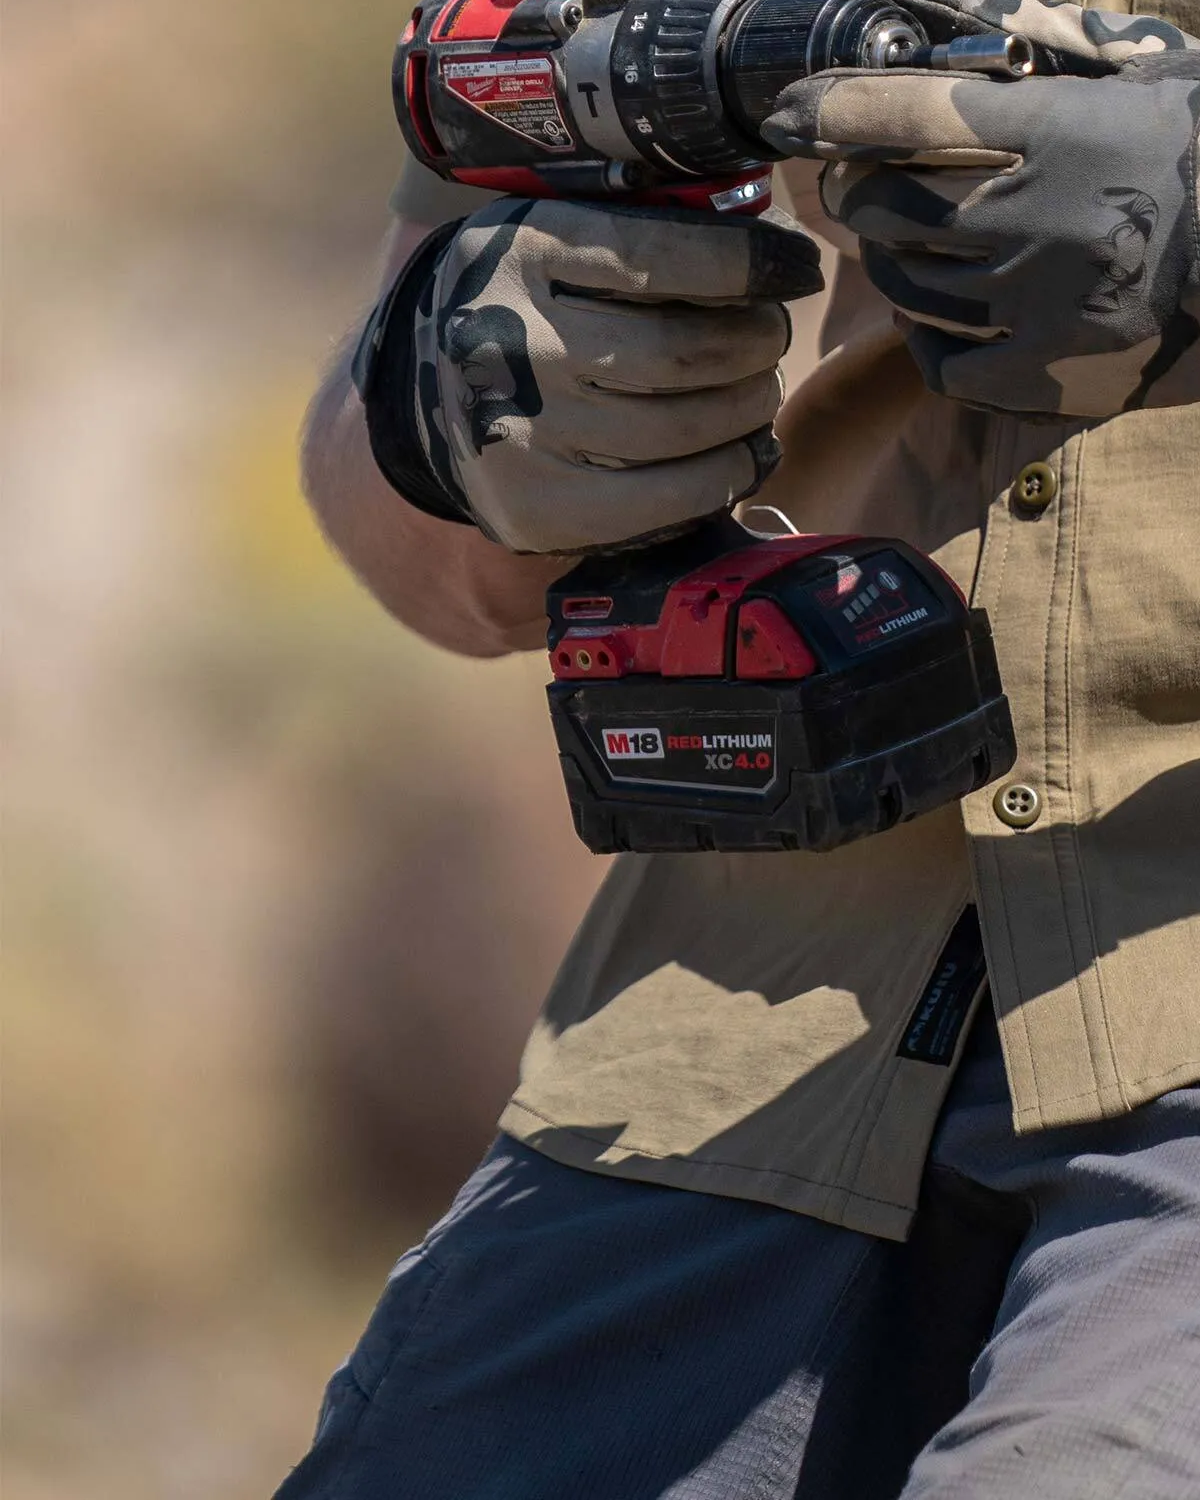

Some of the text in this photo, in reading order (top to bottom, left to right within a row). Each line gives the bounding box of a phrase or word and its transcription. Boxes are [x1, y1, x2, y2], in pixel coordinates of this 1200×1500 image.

[631, 12, 649, 32] 14
[624, 63, 639, 84] 16
[635, 115, 653, 134] 18
[606, 732, 772, 755] M18 REDLITHIUM
